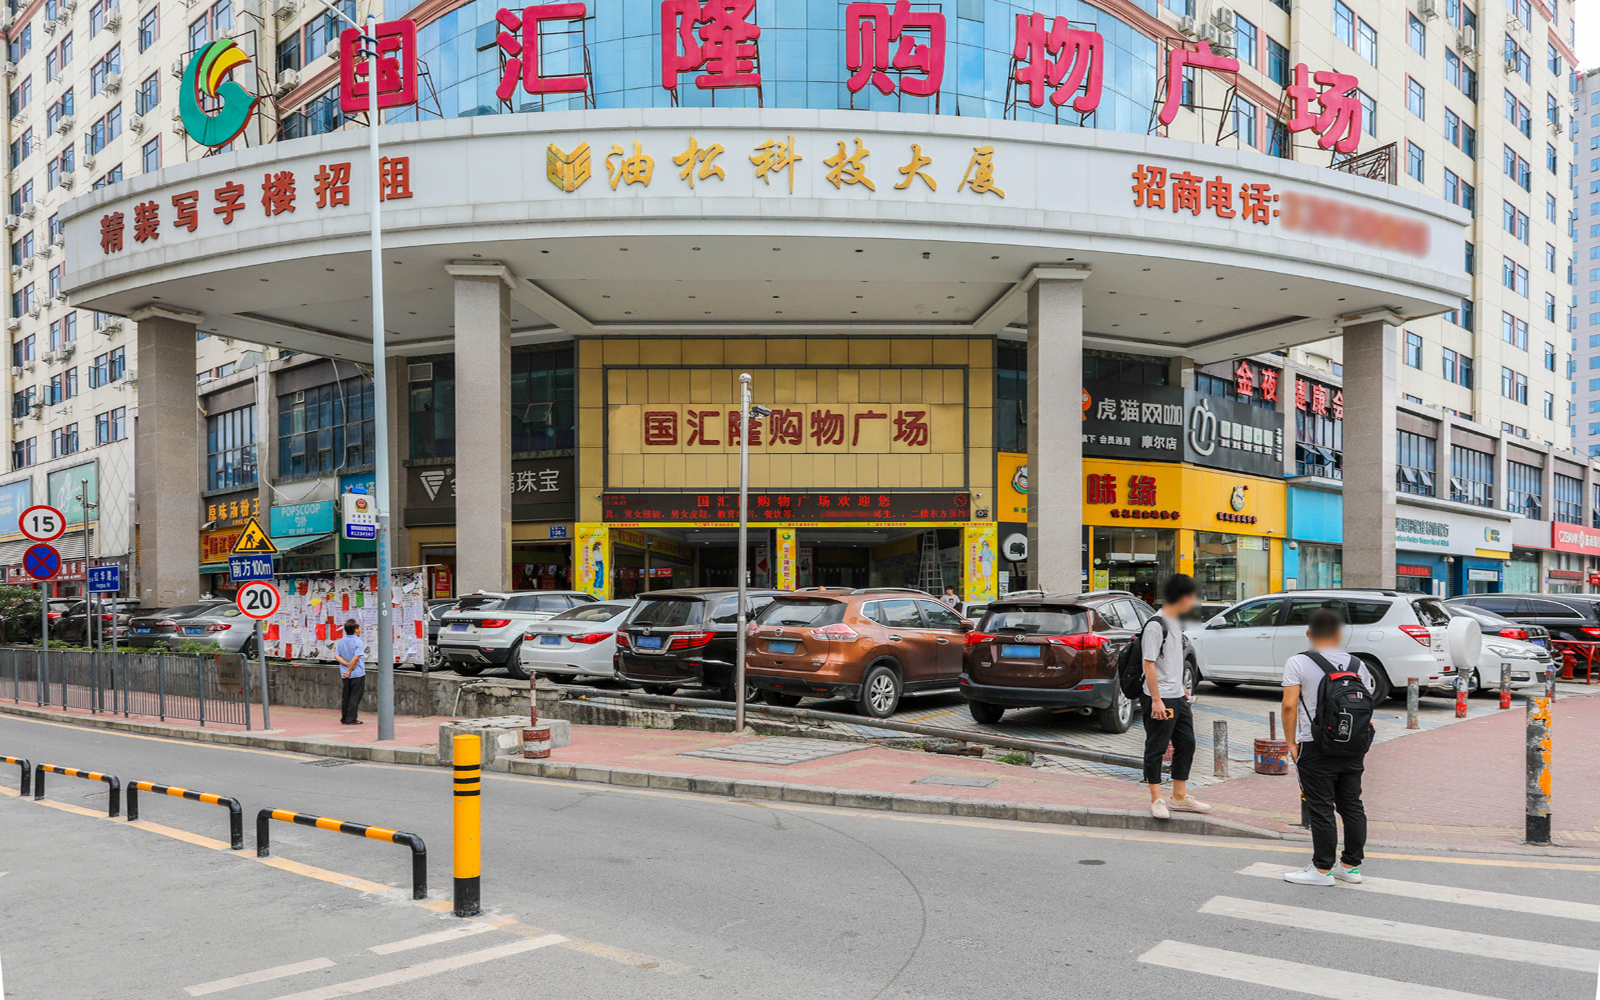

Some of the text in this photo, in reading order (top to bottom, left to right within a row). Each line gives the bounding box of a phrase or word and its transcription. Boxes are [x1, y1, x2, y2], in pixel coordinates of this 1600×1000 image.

[340, 0, 1361, 154] 国汇隆购物广场
[605, 135, 1006, 199] 油松科技大厦
[100, 155, 413, 255] 精装写字楼招租
[1096, 398, 1183, 427] 虎猫网咖
[644, 409, 929, 447] 国汇隆购物广场
[1141, 435, 1178, 451] 摩尔店
[1087, 473, 1157, 506] 味缘
[281, 503, 321, 517] POPSCOOP
[32, 516, 55, 533] 15
[231, 559, 271, 578] 前方100m
[245, 588, 272, 610] 20
[381, 602, 388, 616] 10
